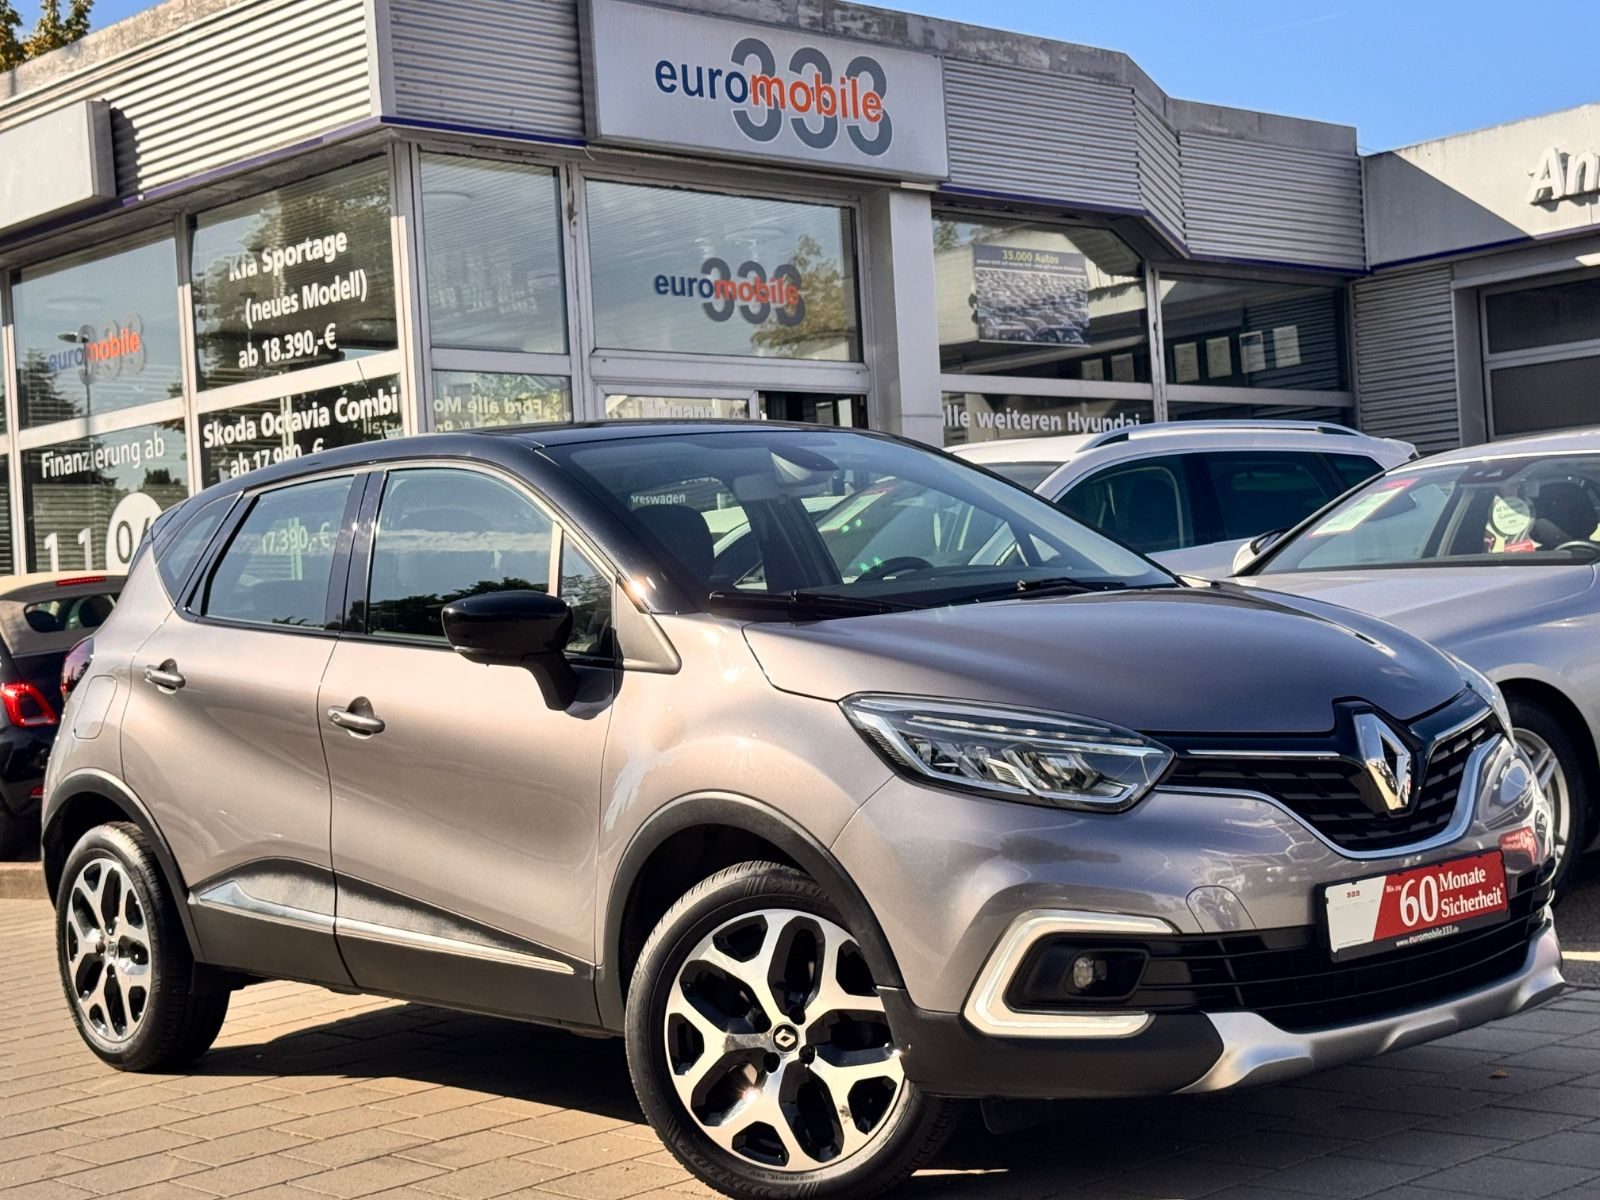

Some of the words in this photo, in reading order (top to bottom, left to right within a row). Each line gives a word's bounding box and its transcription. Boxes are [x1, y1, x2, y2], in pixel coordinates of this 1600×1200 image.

[655, 59, 884, 123] euromobile
[731, 37, 893, 156] 333
[1527, 147, 1600, 201] An
[262, 232, 347, 276] Sportage
[1002, 249, 1033, 262] 35.000
[245, 292, 299, 329] (neues
[302, 268, 368, 310] Modell)
[655, 272, 800, 305] euromobile
[701, 257, 806, 327] 333
[48, 328, 141, 374] euromobile
[239, 342, 258, 369] ab
[203, 415, 257, 449] Skoda
[261, 402, 331, 437] Octavia
[334, 386, 399, 423] Combi
[977, 407, 1062, 431] weiteren
[1067, 411, 1141, 433] Hyundai
[41, 440, 140, 479] Finanzierung
[145, 430, 165, 459] ab
[230, 452, 250, 479] ab
[1400, 875, 1439, 927] 60
[1439, 867, 1486, 892] Monate
